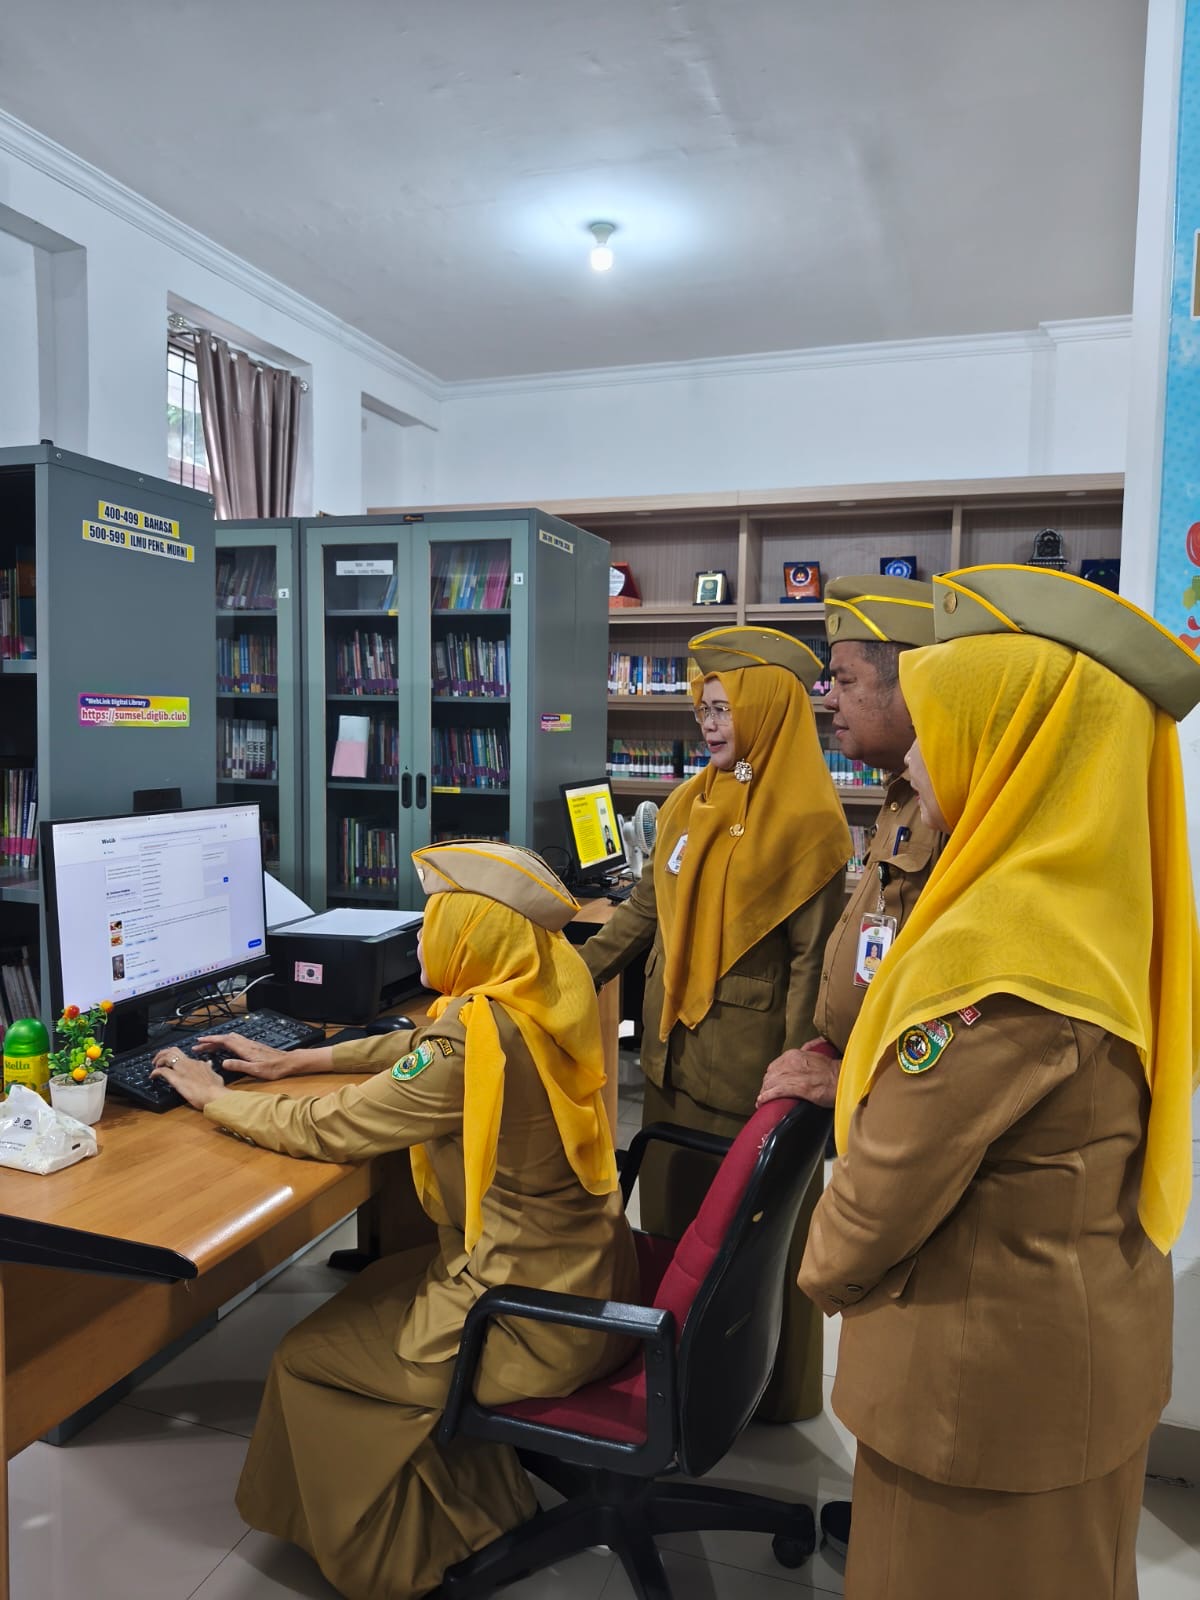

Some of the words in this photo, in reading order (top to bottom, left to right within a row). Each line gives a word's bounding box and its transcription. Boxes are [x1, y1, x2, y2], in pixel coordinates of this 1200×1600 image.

[104, 505, 139, 526] 400-499
[144, 516, 173, 534] BAHASA
[89, 525, 126, 545] 500-599
[130, 535, 147, 550] ILMU
[111, 698, 128, 707] Digital
[129, 699, 147, 708] Library
[81, 709, 187, 722] https://sumsel.diglib.club
